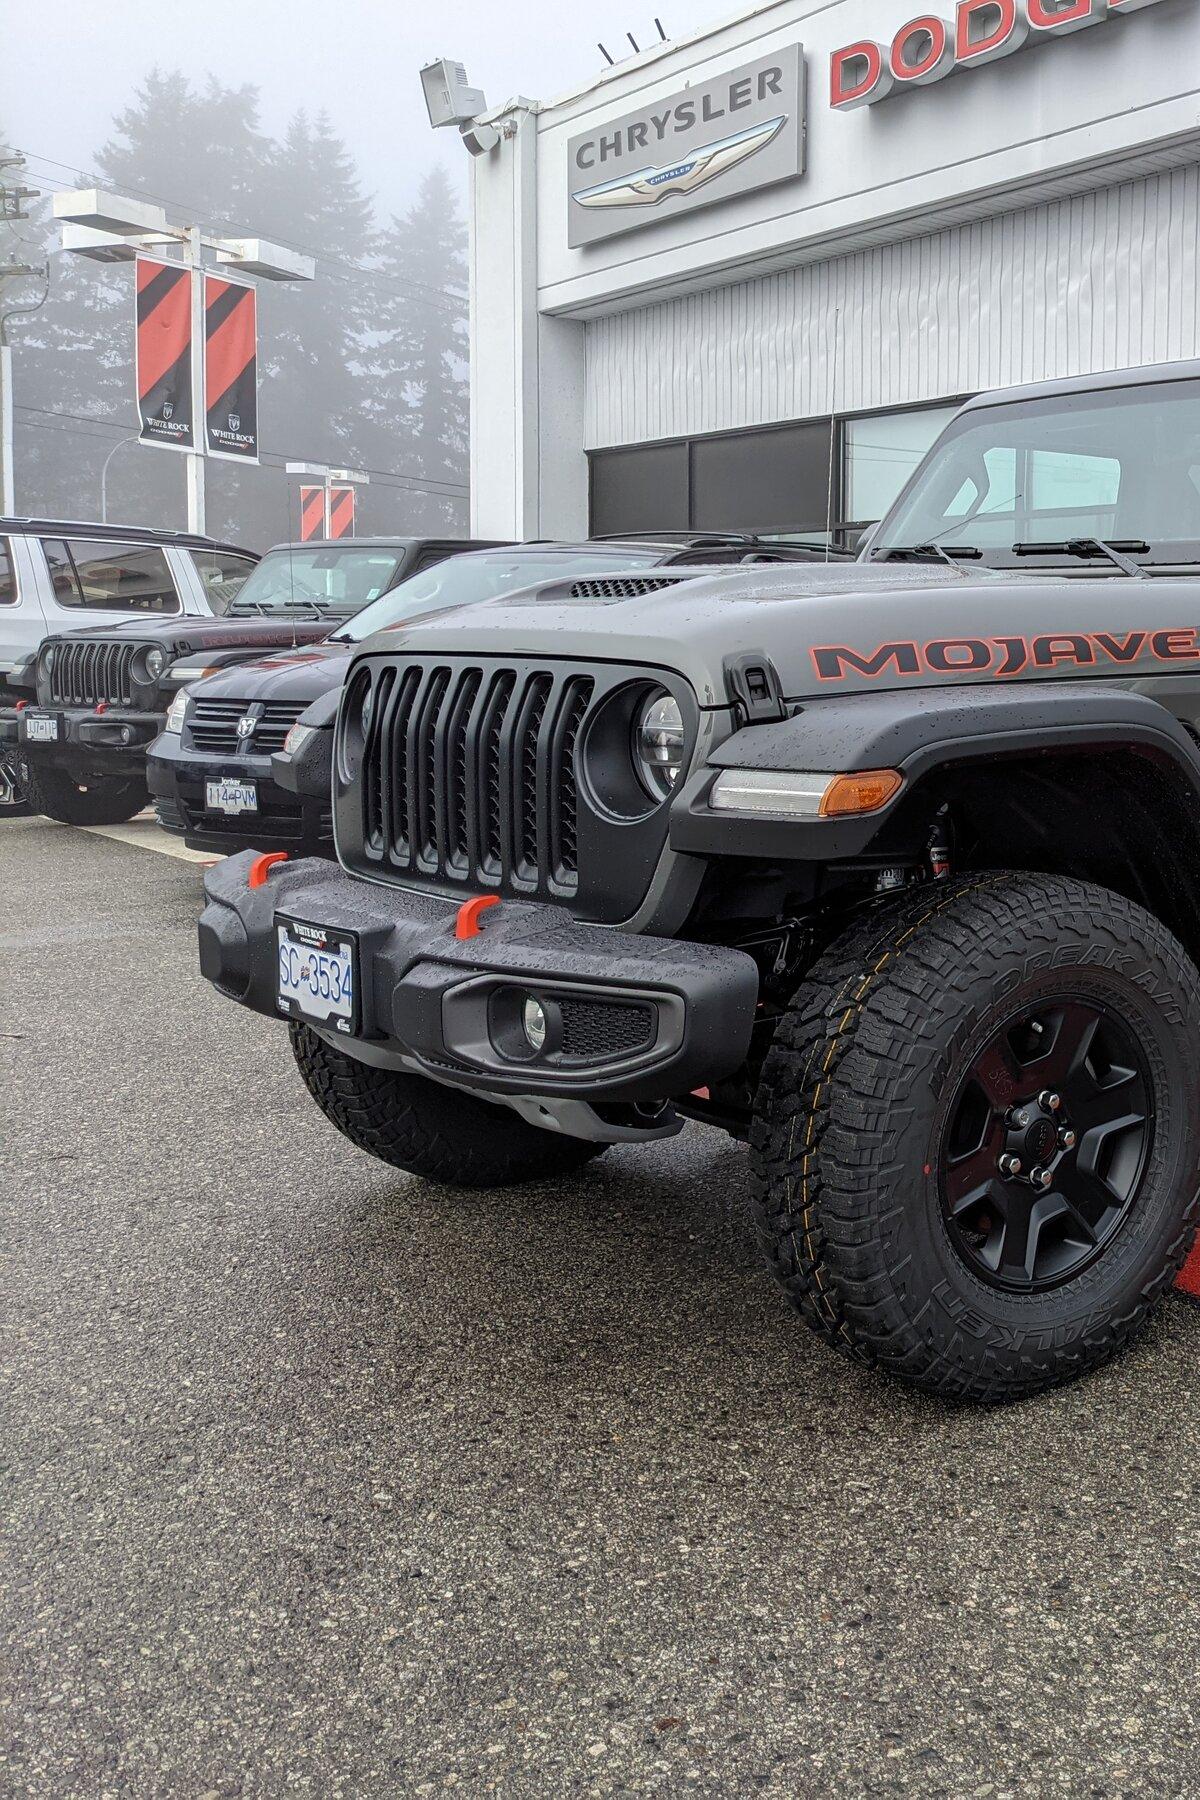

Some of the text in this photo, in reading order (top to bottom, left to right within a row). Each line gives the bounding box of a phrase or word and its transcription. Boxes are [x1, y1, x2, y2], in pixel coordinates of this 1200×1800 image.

[829, 0, 1133, 107] DOD
[575, 66, 783, 170] CHRYSLER
[650, 165, 691, 185] CHRYSLER
[146, 417, 190, 433] WHITE ROCK
[211, 429, 254, 444] WHITE ROCK
[210, 787, 228, 805] 114
[280, 944, 352, 1008] SC 3534
